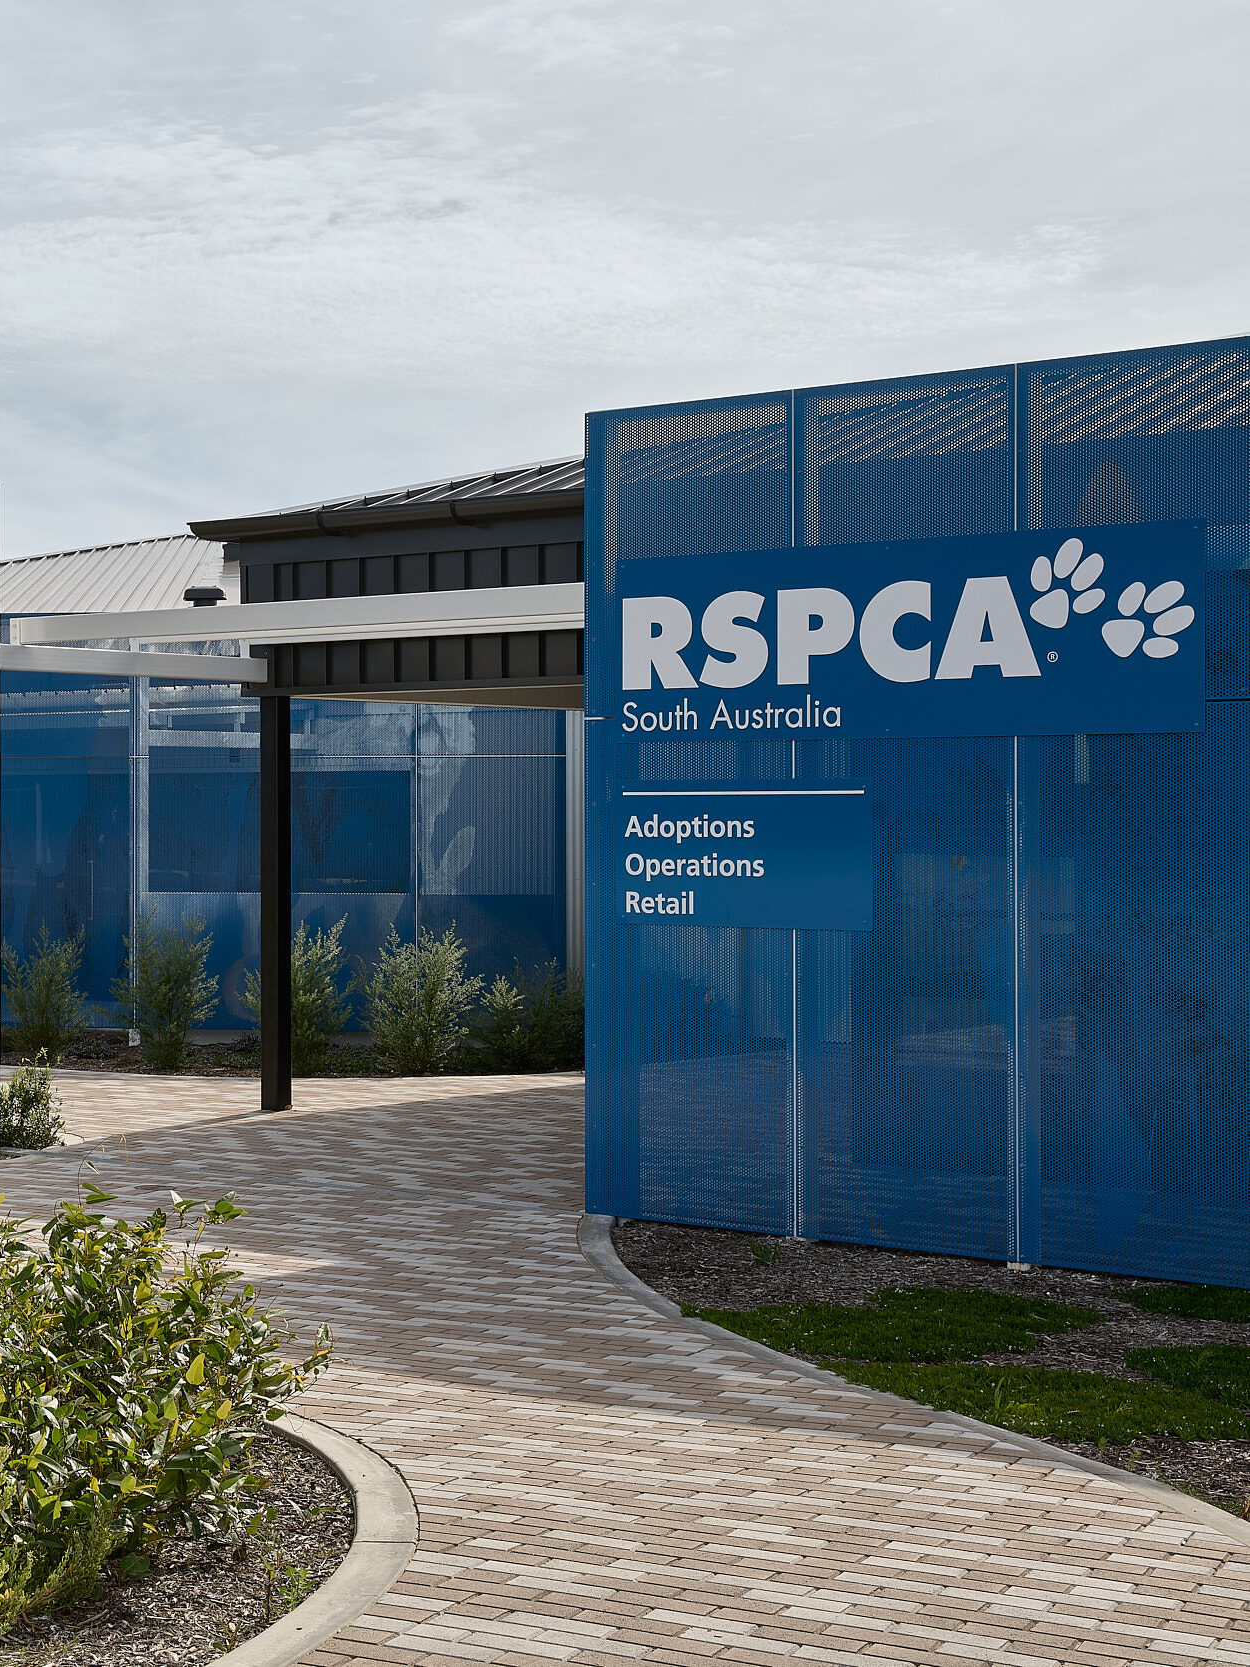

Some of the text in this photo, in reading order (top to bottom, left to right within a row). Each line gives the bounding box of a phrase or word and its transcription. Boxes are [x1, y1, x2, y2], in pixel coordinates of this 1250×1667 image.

[622, 576, 1042, 690] RSPCA
[622, 694, 842, 732] South Australia
[625, 814, 755, 843] Adoptions
[626, 853, 765, 882] Operations
[626, 891, 694, 915] Retail
